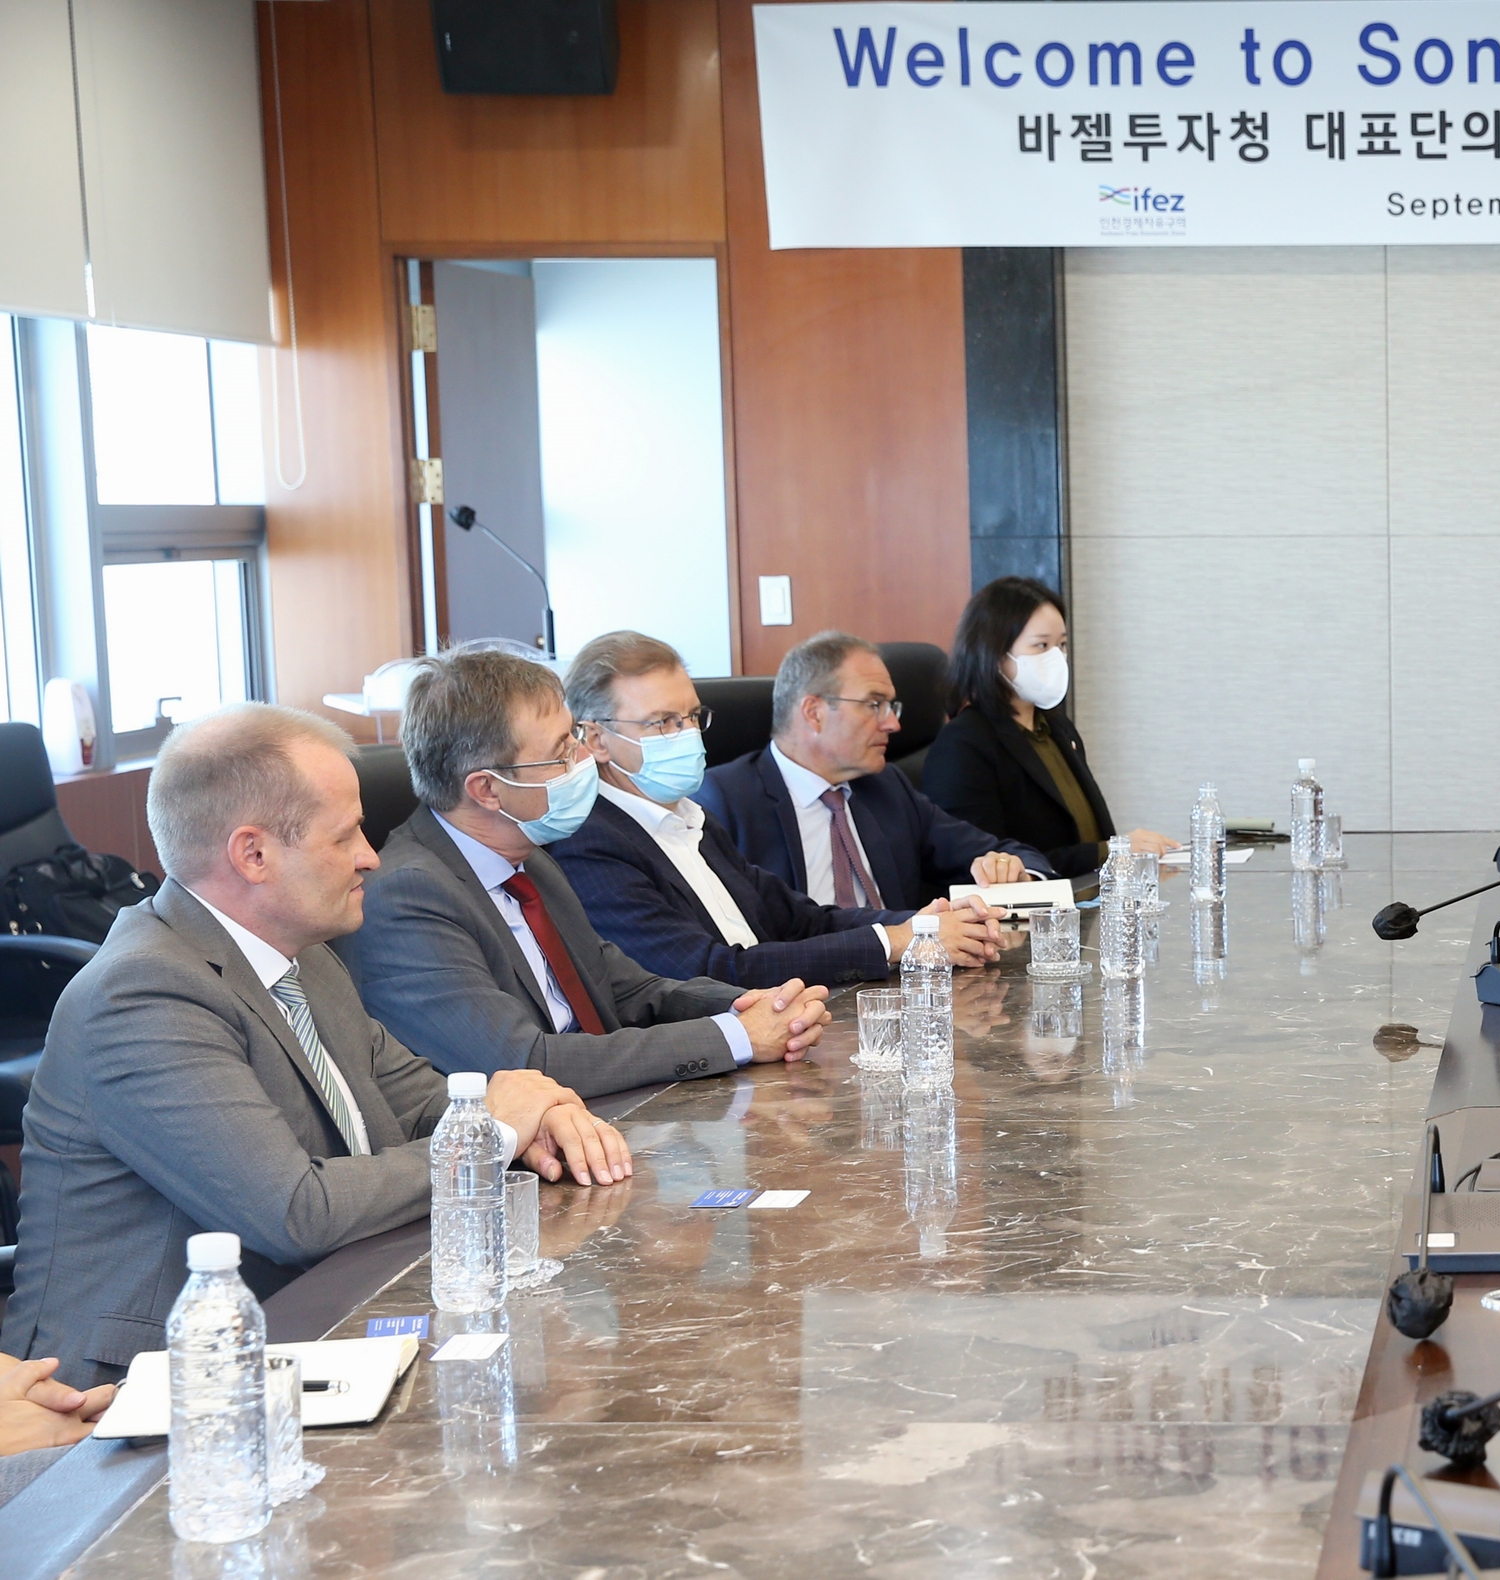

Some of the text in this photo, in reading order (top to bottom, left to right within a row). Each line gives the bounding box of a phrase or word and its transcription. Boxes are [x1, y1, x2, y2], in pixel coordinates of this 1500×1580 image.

[832, 25, 1196, 88] Welcome
[1240, 27, 1314, 87] to
[1018, 111, 1270, 163] 바젤투자청
[1133, 187, 1185, 212] ifez
